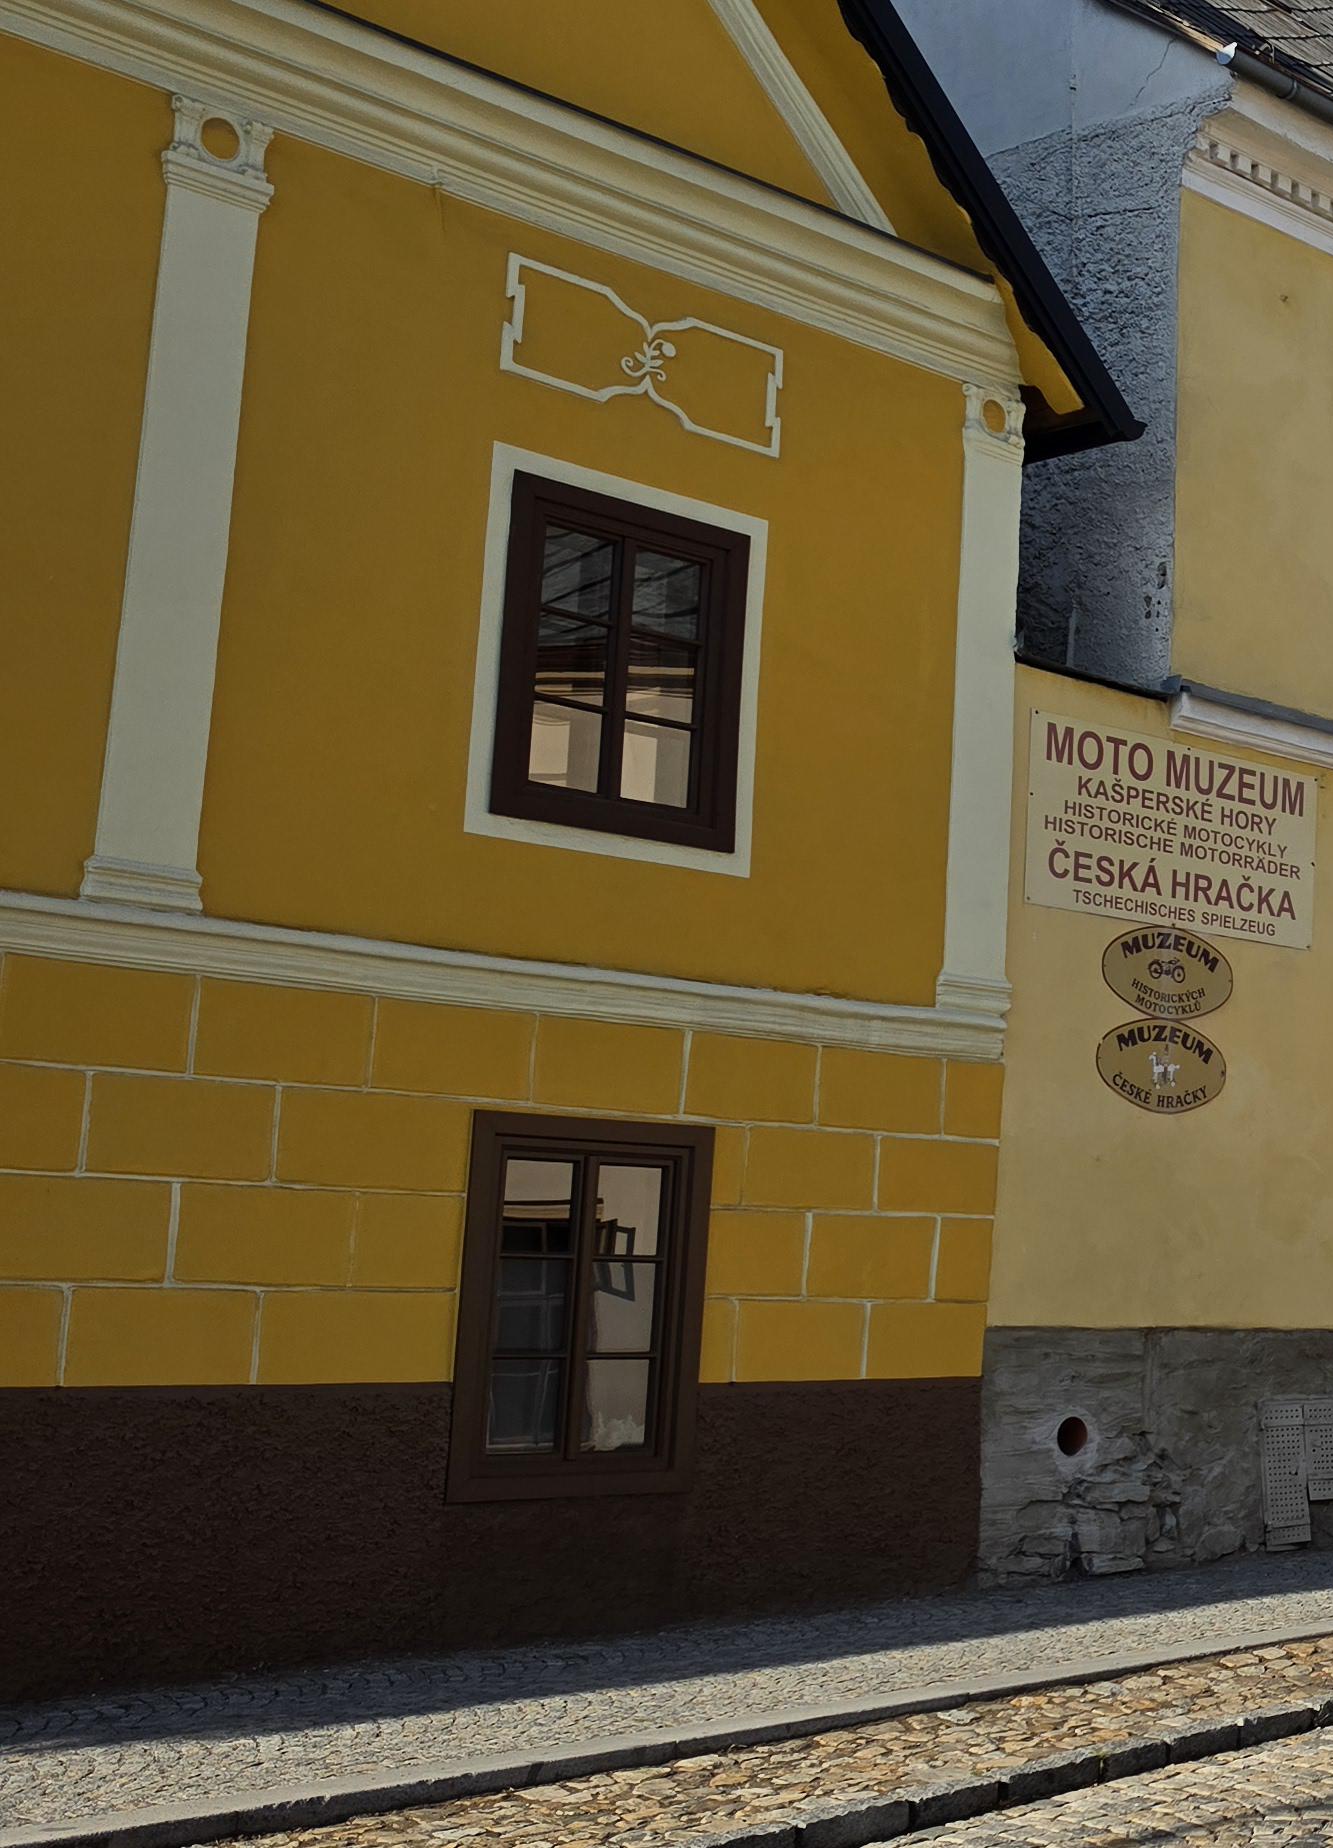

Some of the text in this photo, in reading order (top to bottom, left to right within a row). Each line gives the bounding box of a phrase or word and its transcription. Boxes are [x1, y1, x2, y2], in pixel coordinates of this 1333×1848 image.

[1046, 722, 1305, 817] MOTO MUZEUM
[1064, 800, 1287, 859] HISTORICKÉ MOTOCYKLY
[1077, 775, 1277, 836] KAŠPERSKÉ HORY
[1044, 815, 1301, 880] HISTORISCHE MOTORRÄDER
[1048, 839, 1296, 921] ČESKÁ HRAČKA
[1073, 889, 1276, 937] TSCHECHISCHES SPIELZEUG
[1120, 932, 1220, 973] MUZEUM
[1131, 978, 1206, 1003] HISTORICKÝCH
[1134, 994, 1202, 1015] MOTOCYKLŮ
[1116, 1025, 1213, 1065] MUZEUM
[1112, 1072, 1208, 1108] ČESKÉ HRAČKY
